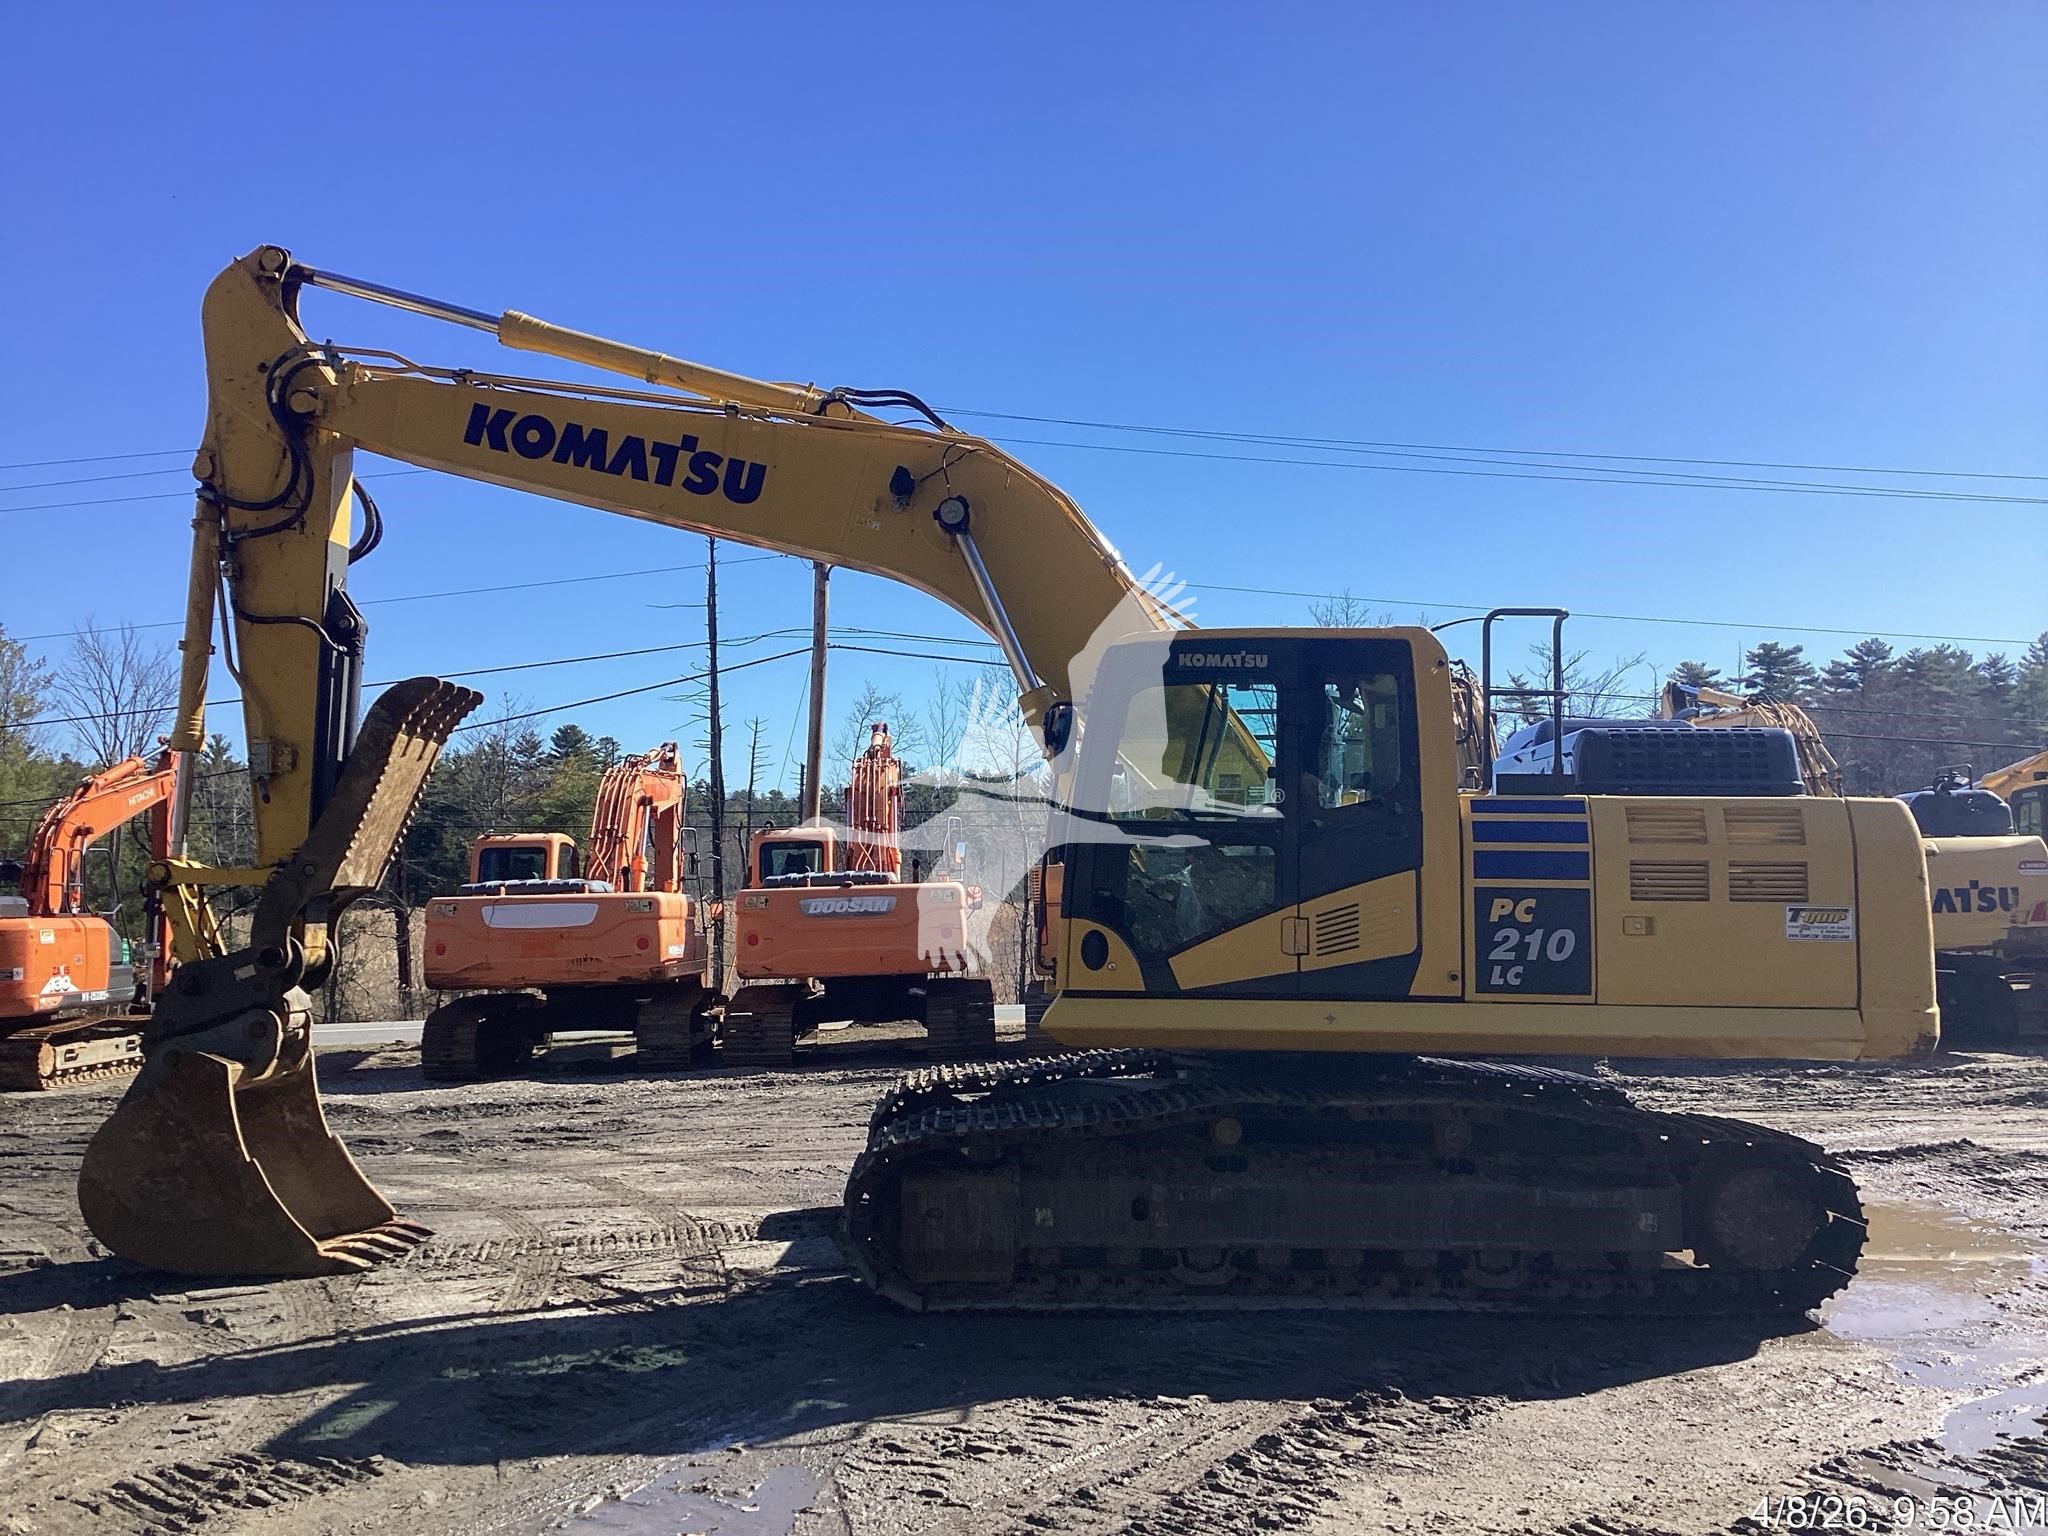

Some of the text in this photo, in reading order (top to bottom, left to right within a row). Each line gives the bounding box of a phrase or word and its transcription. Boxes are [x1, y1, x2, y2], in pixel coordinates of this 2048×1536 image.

[464, 402, 767, 504] KOMATSU
[1178, 650, 1268, 668] KOMATSU
[807, 899, 890, 914] DOOSAN
[1932, 880, 2020, 913] ATSU
[1489, 898, 1537, 923] PC
[1488, 927, 1576, 961] 210
[1490, 965, 1524, 986] LC
